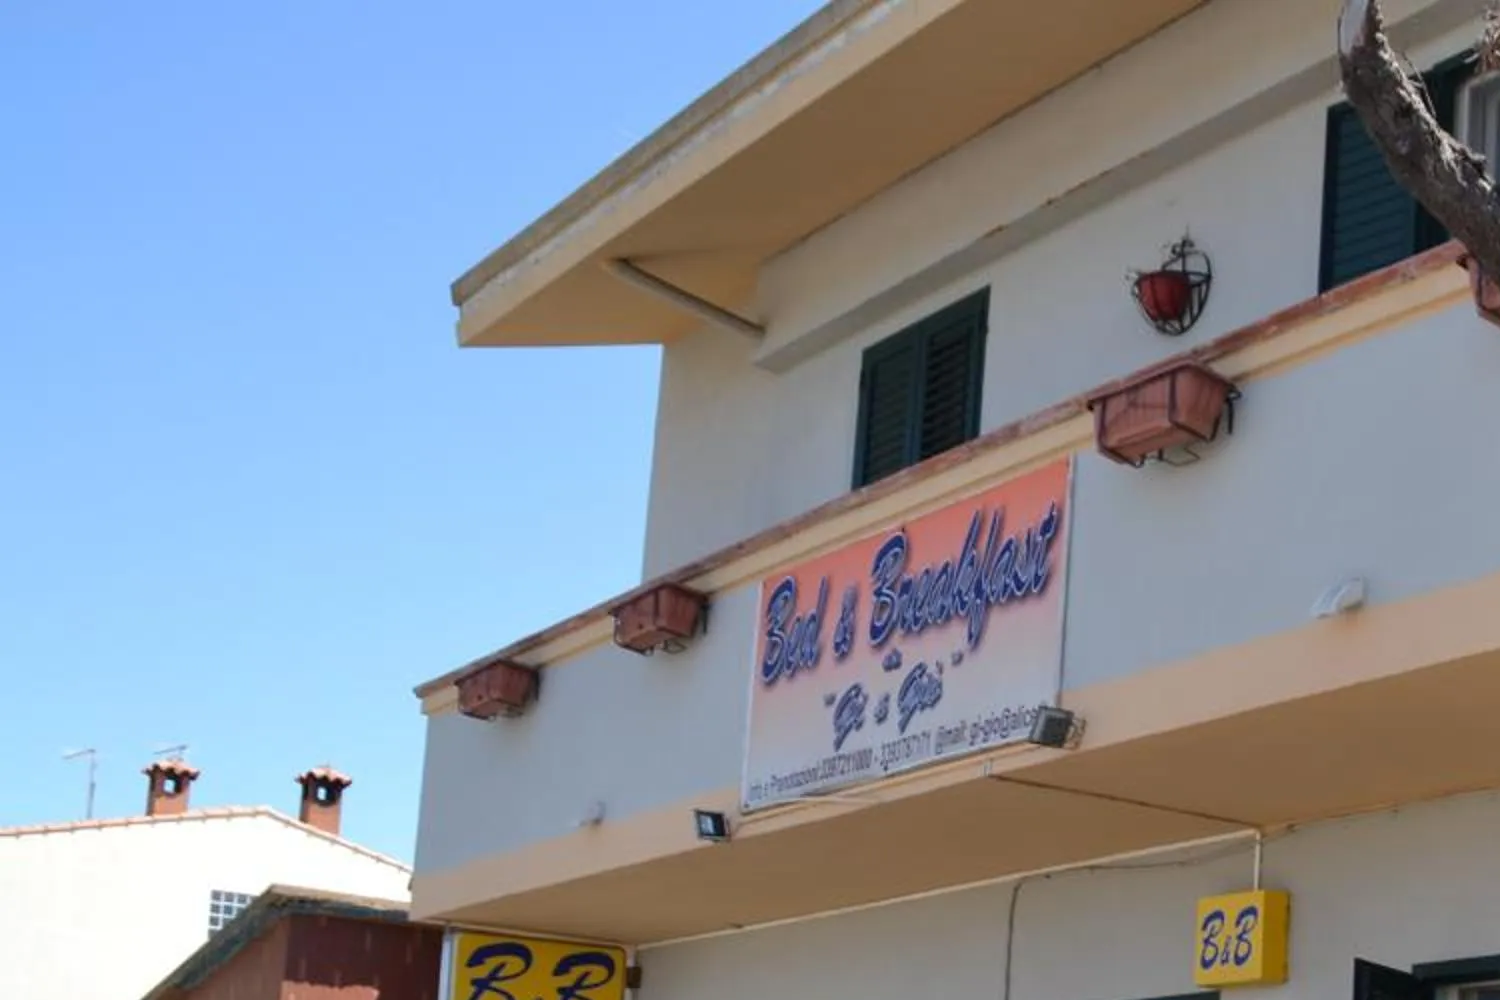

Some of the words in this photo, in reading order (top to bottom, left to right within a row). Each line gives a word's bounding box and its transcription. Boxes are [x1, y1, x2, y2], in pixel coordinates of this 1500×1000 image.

[762, 575, 828, 684] Bed
[833, 588, 857, 659] &
[870, 502, 1060, 650] Breakfast
[1200, 905, 1259, 970] B&B
